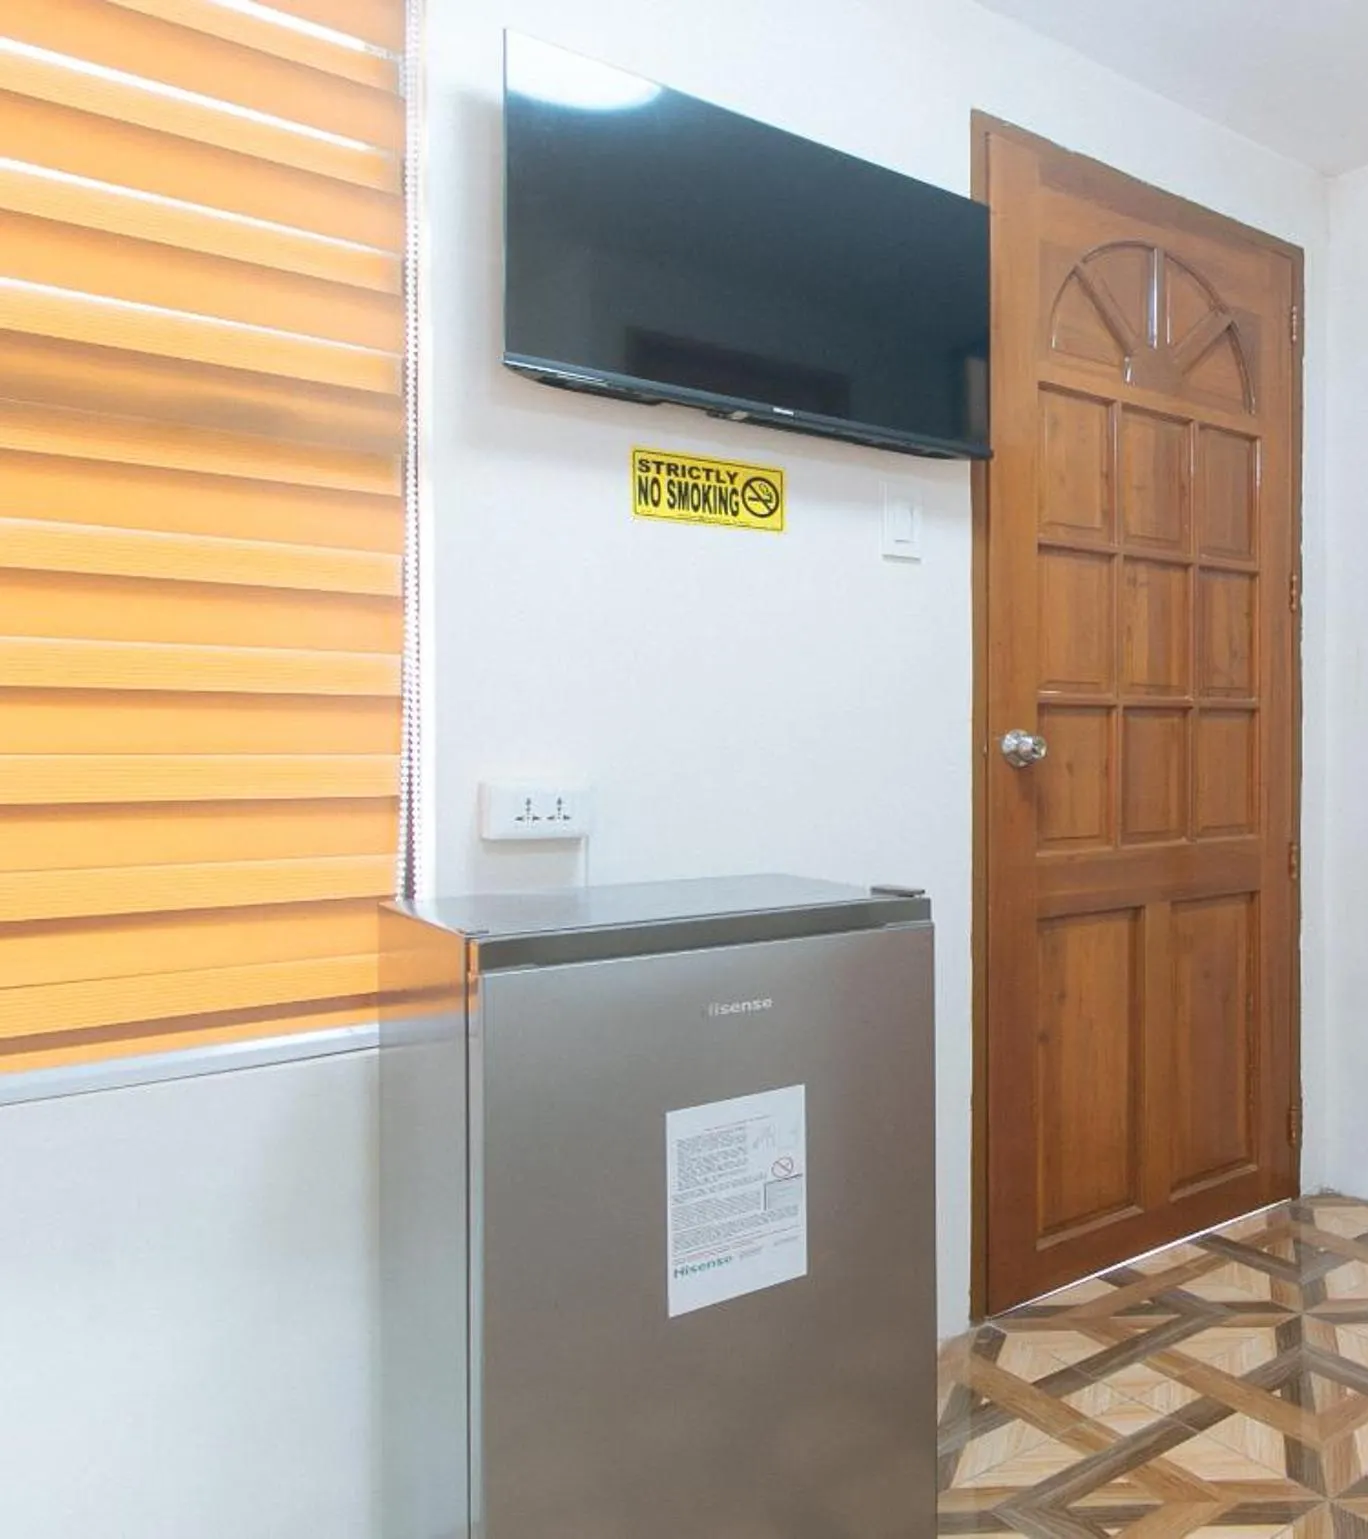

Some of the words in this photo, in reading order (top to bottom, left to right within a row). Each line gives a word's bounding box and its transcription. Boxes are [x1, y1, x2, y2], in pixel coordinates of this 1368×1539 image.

[638, 459, 738, 485] STRICTLY
[638, 475, 661, 507] NO
[667, 478, 739, 517] SMOKING
[673, 1255, 733, 1279] Hisense
